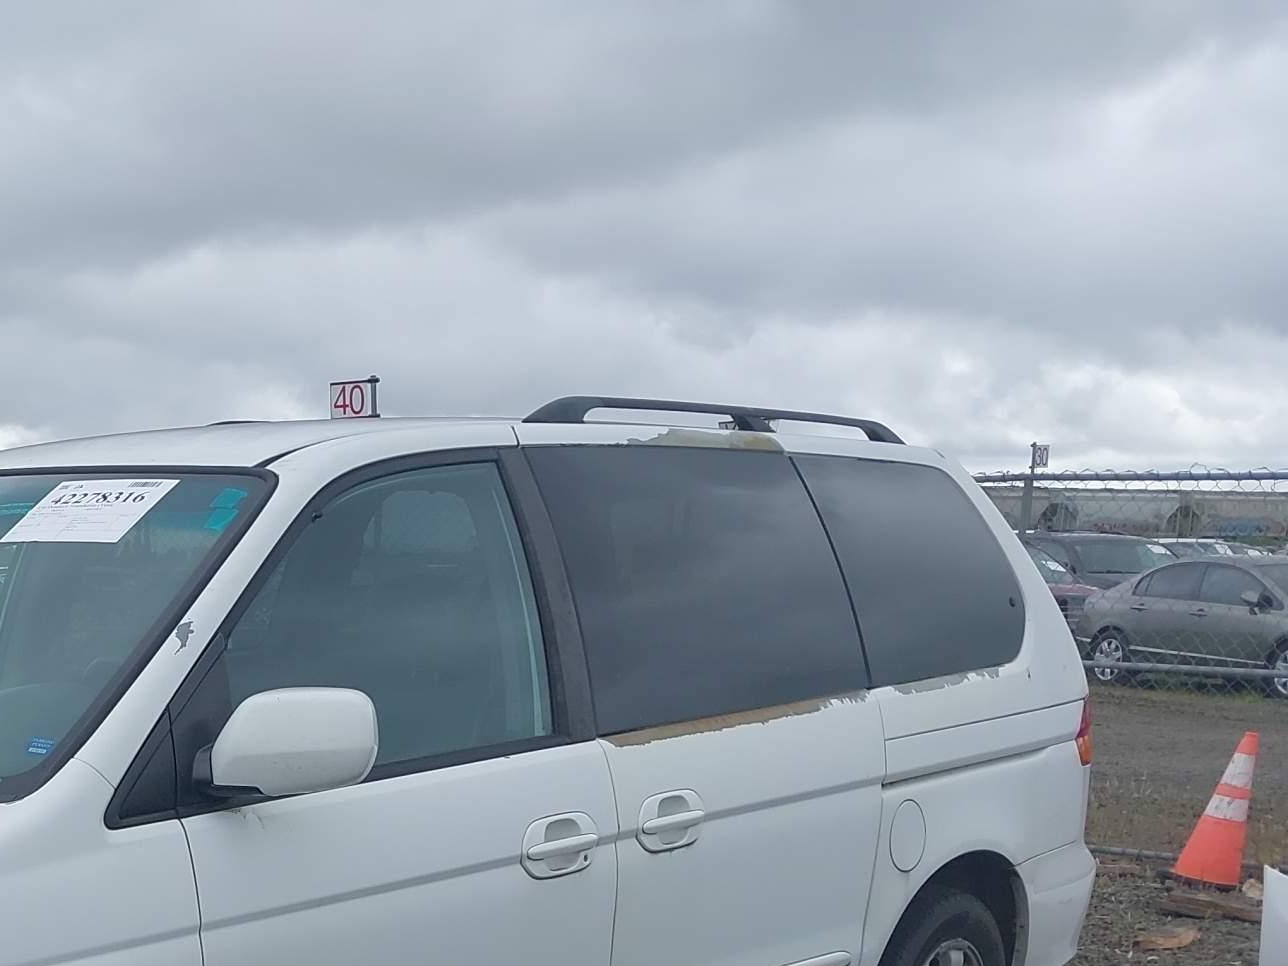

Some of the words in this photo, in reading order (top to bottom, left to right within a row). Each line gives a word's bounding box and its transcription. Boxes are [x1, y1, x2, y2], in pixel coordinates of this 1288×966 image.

[333, 384, 365, 415] 40
[1035, 447, 1049, 466] 30
[50, 490, 150, 506] 42278316
